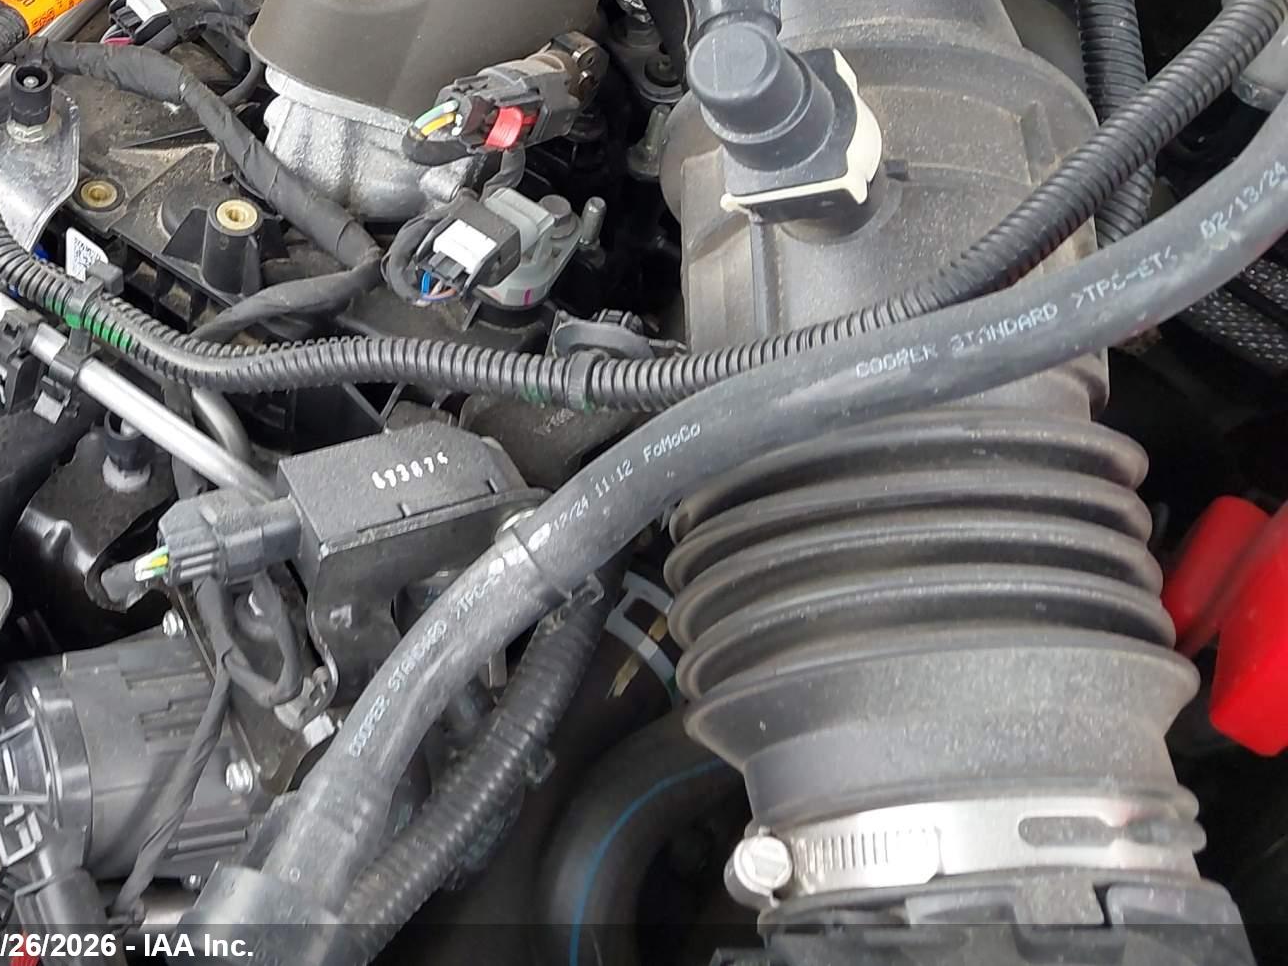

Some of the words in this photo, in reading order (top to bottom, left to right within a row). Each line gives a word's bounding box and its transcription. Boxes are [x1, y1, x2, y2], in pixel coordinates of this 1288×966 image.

[593, 458, 634, 499] 11:12
[643, 421, 701, 463] FoMoCo
[855, 342, 939, 379] COOPER
[949, 302, 1059, 354] STANDARD
